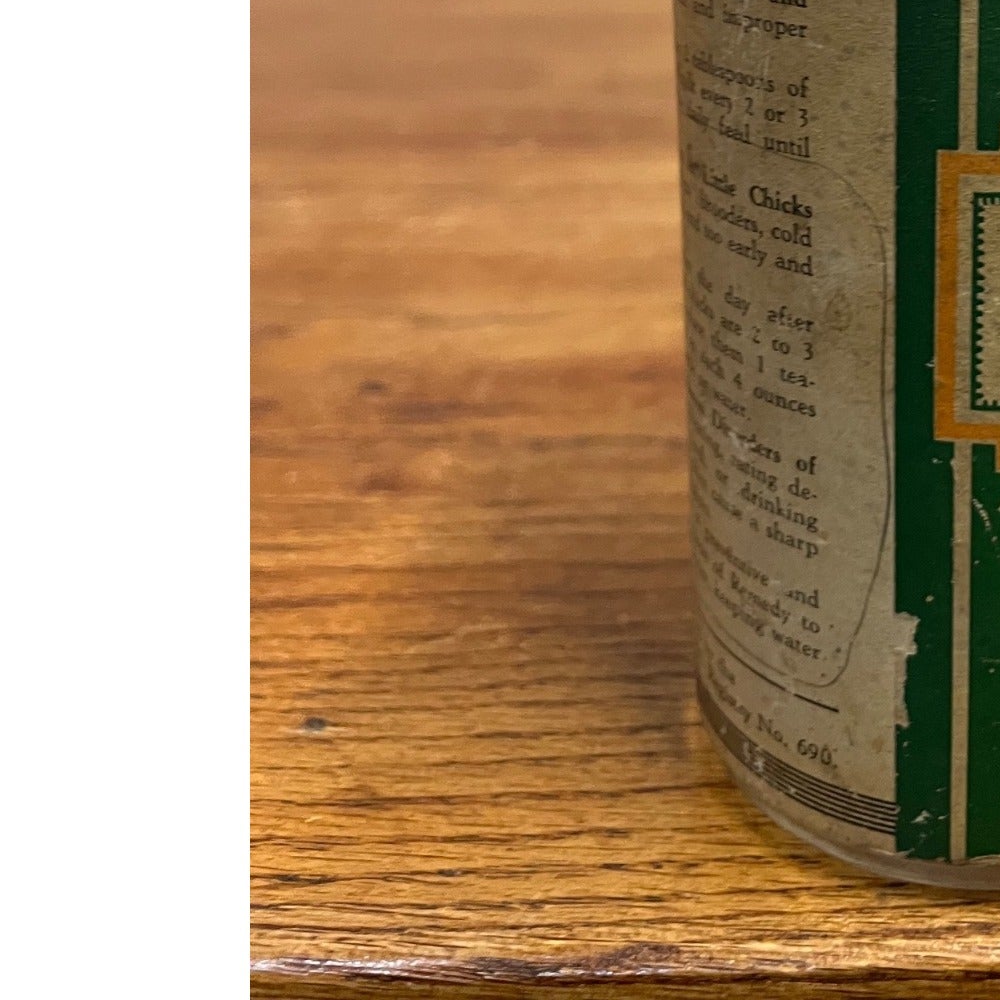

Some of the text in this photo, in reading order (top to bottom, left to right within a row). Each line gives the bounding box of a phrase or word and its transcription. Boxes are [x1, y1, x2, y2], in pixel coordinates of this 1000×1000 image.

[787, 76, 810, 98] of
[745, 97, 755, 116] 2
[764, 107, 786, 124] or
[798, 108, 809, 128] 3
[764, 137, 810, 158] until
[749, 185, 813, 219] Chicks
[771, 223, 812, 248] cold
[727, 239, 768, 267] early
[775, 255, 814, 277] and
[767, 305, 815, 333] after
[772, 337, 791, 355] to
[803, 342, 815, 361] 3
[779, 368, 816, 388] tea-
[752, 386, 817, 418] ounces
[796, 456, 817, 475] of
[788, 478, 817, 501] de-
[738, 482, 818, 533] drinking
[766, 522, 819, 559] sharp
[801, 615, 821, 634] to
[757, 713, 838, 770] No. 690.
